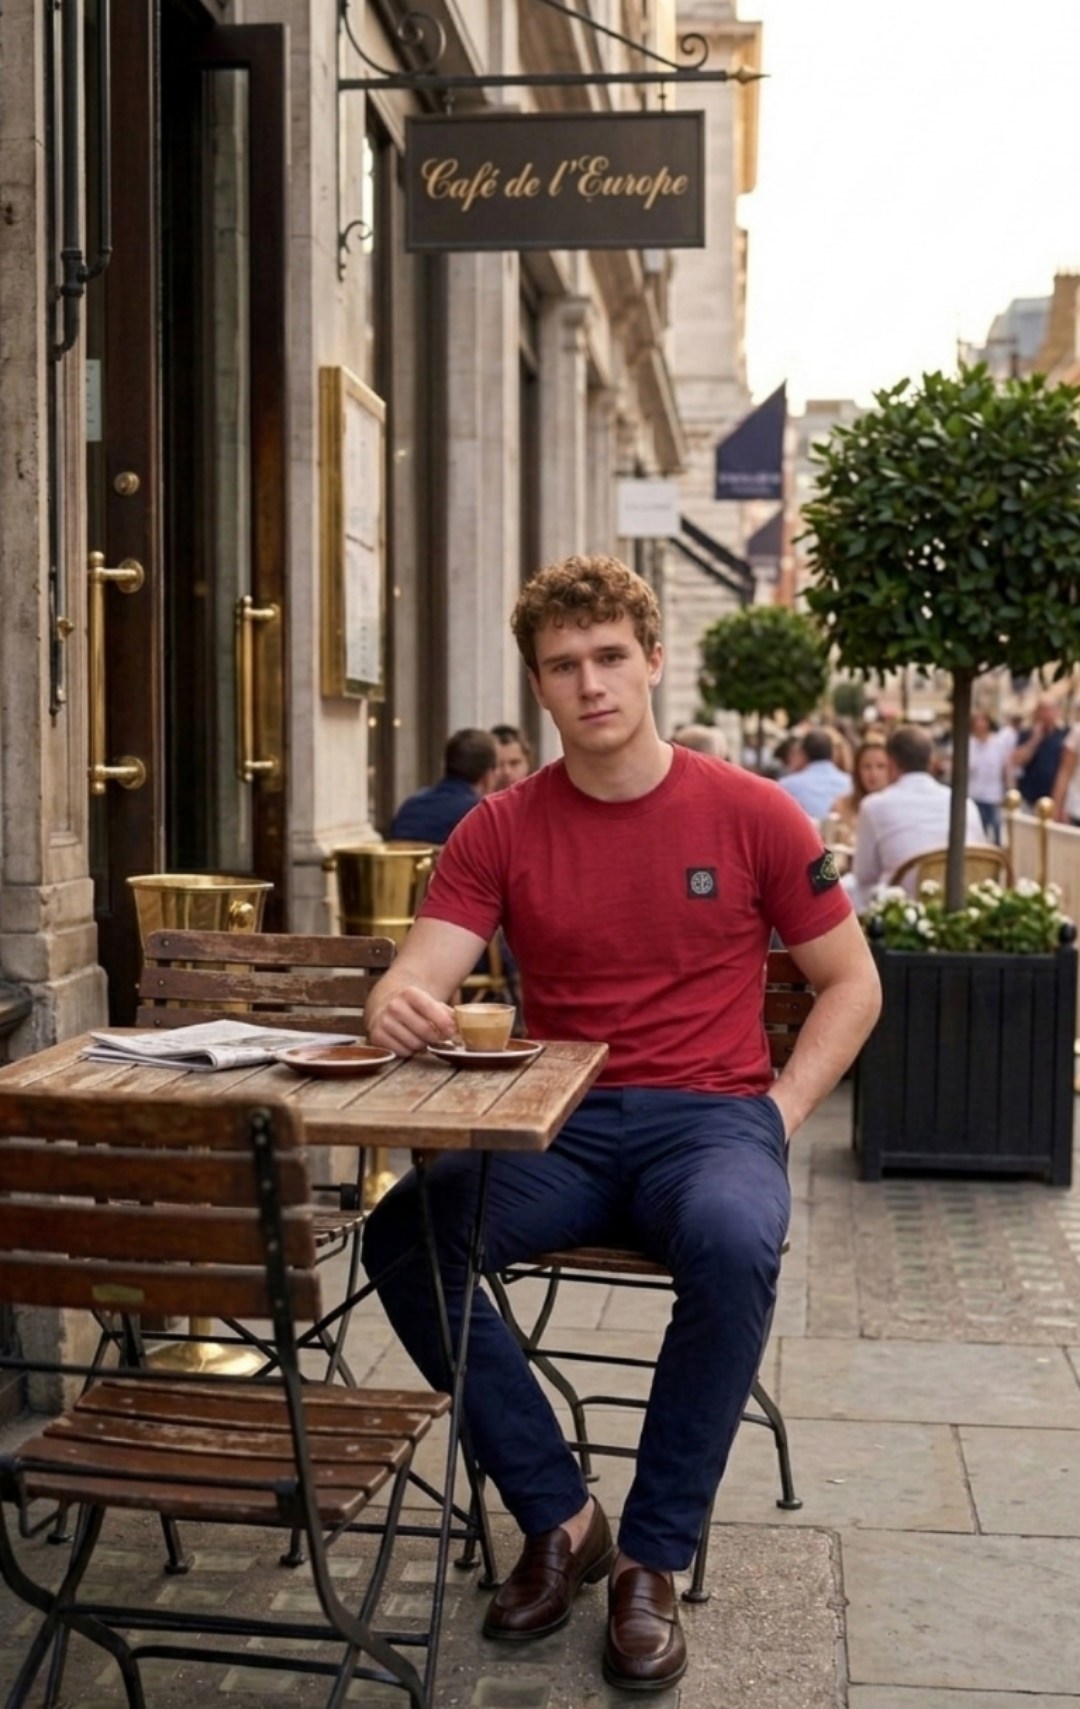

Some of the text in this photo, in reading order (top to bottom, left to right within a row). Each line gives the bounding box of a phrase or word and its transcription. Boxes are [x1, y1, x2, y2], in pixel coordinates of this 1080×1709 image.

[421, 155, 689, 212] Café de l'Europe
